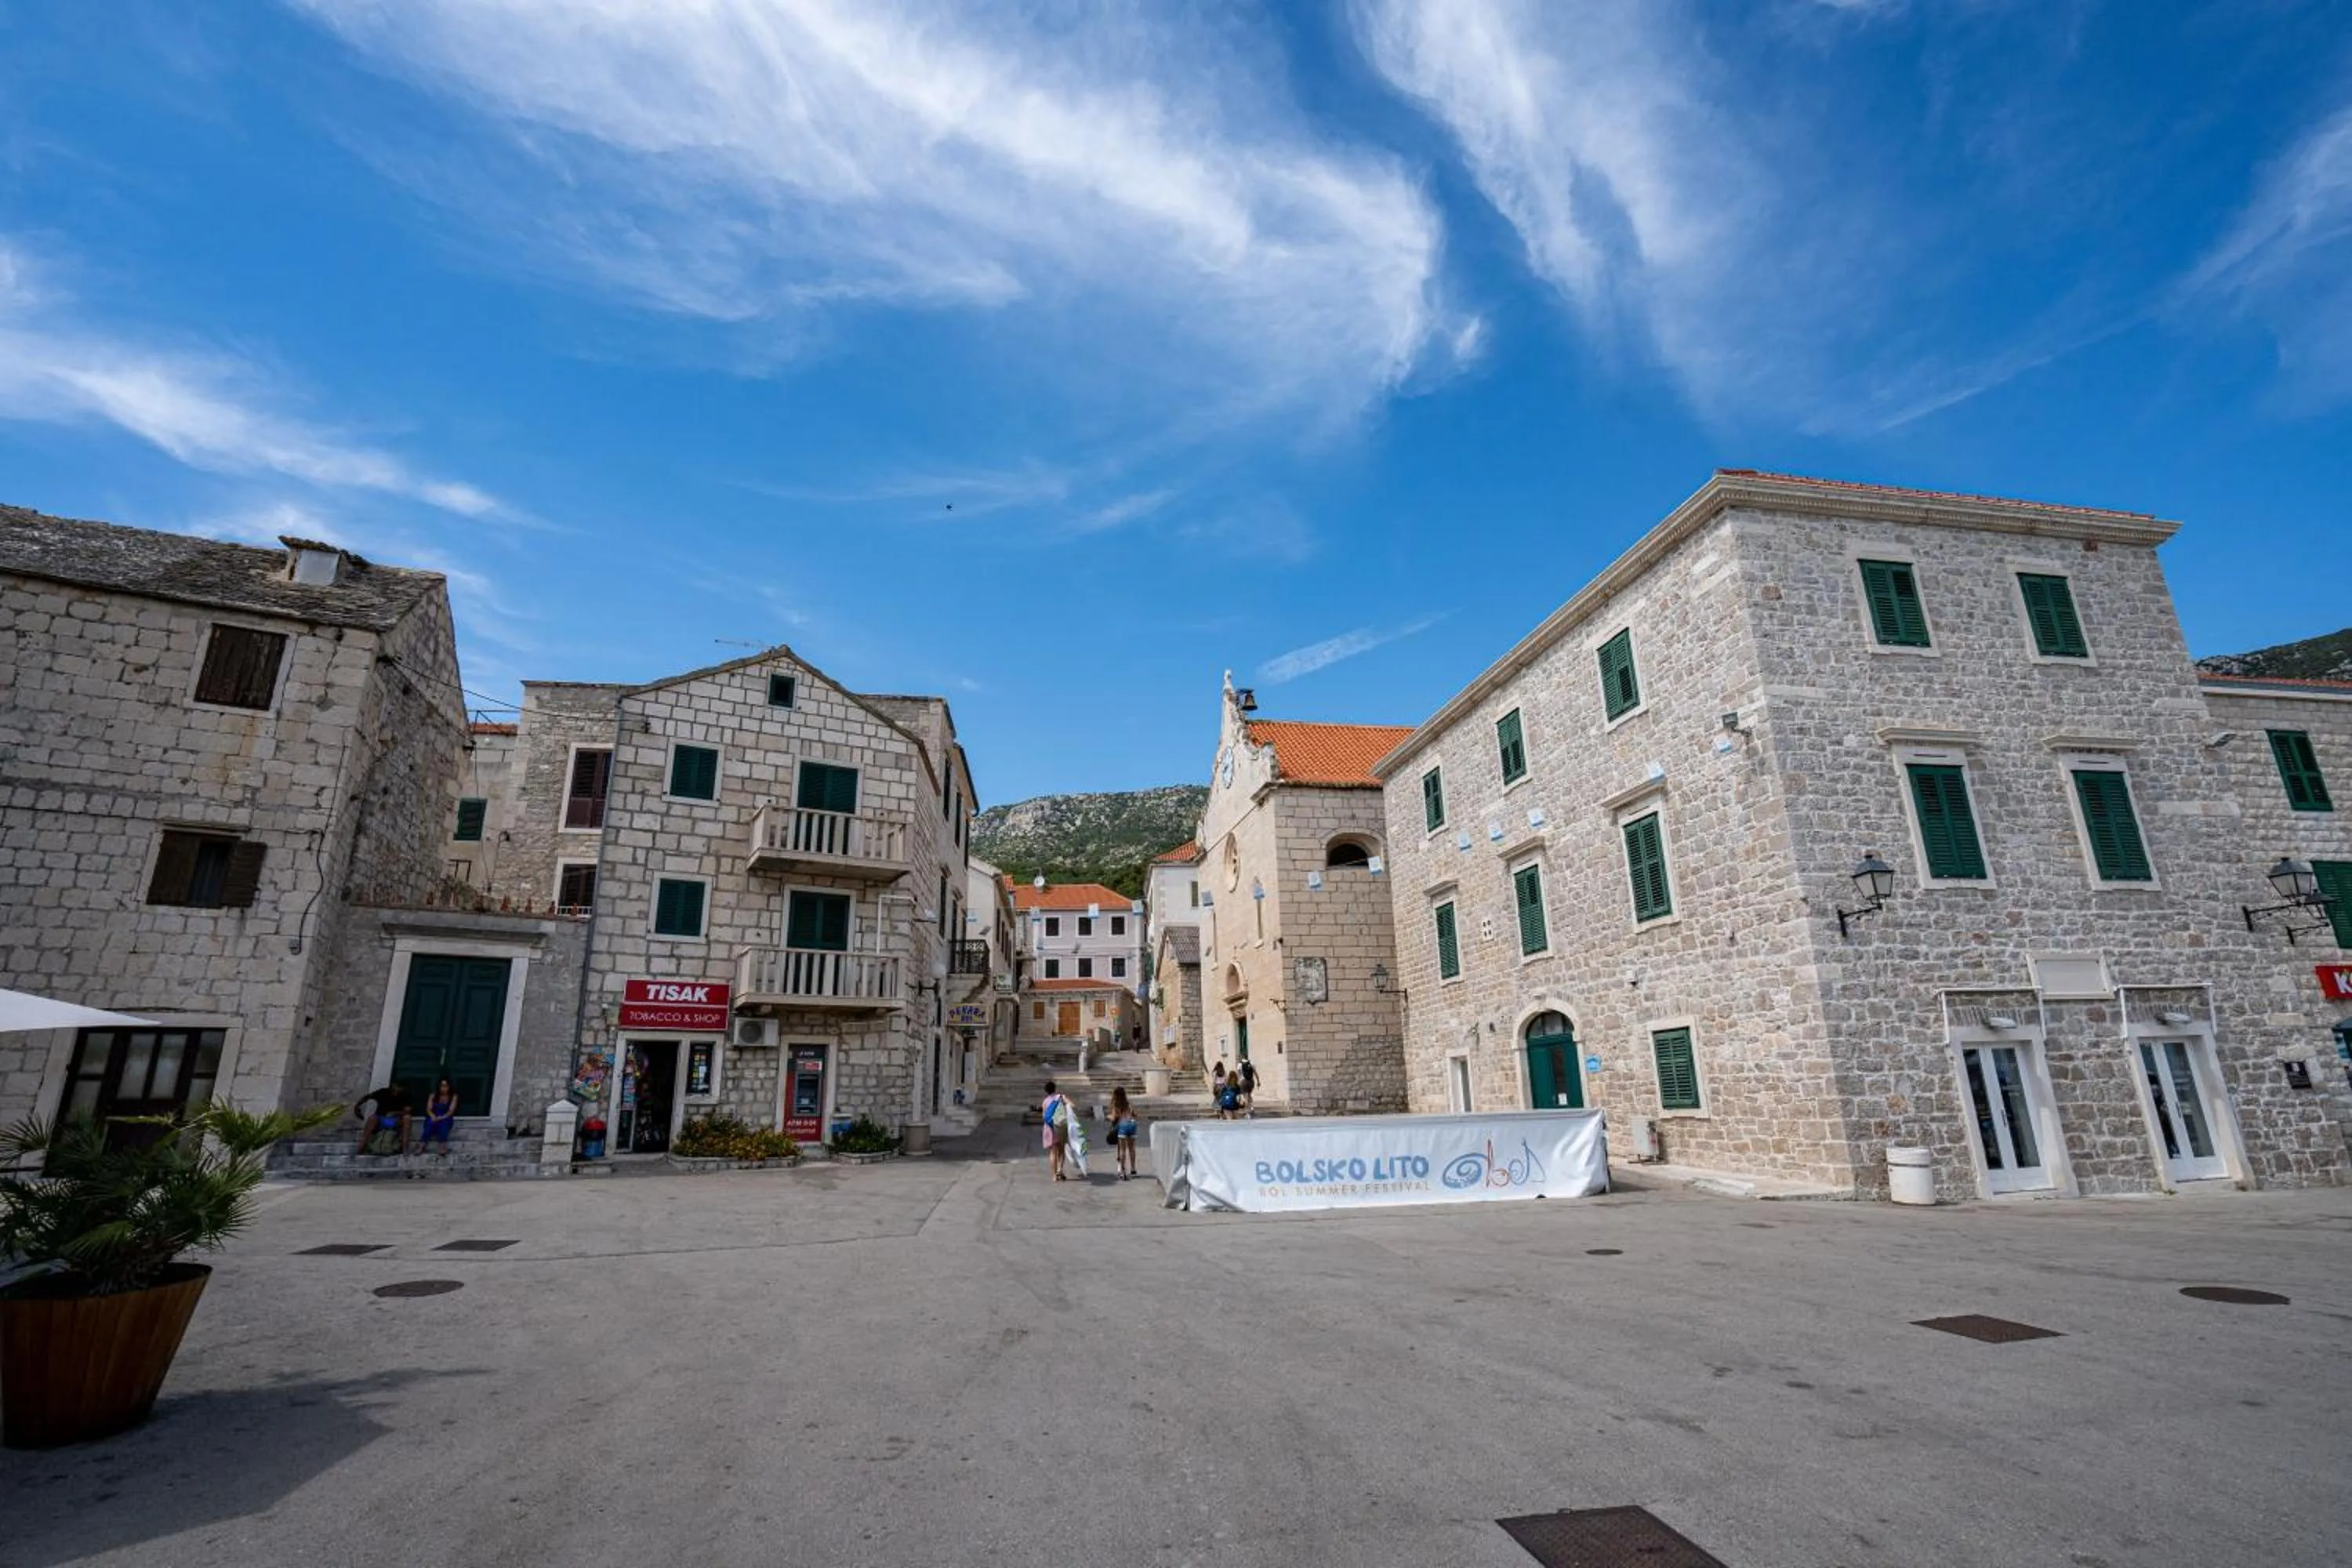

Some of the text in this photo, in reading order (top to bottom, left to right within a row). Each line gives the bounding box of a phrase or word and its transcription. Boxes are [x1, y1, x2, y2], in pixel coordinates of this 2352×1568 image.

[646, 985, 710, 1003] TISAK
[630, 1011, 720, 1024] TOBACCO & SHOP
[1255, 1155, 1429, 1184] BOLSKO LITO
[1258, 1181, 1432, 1198] BOL SUMMER FESTIVAL
